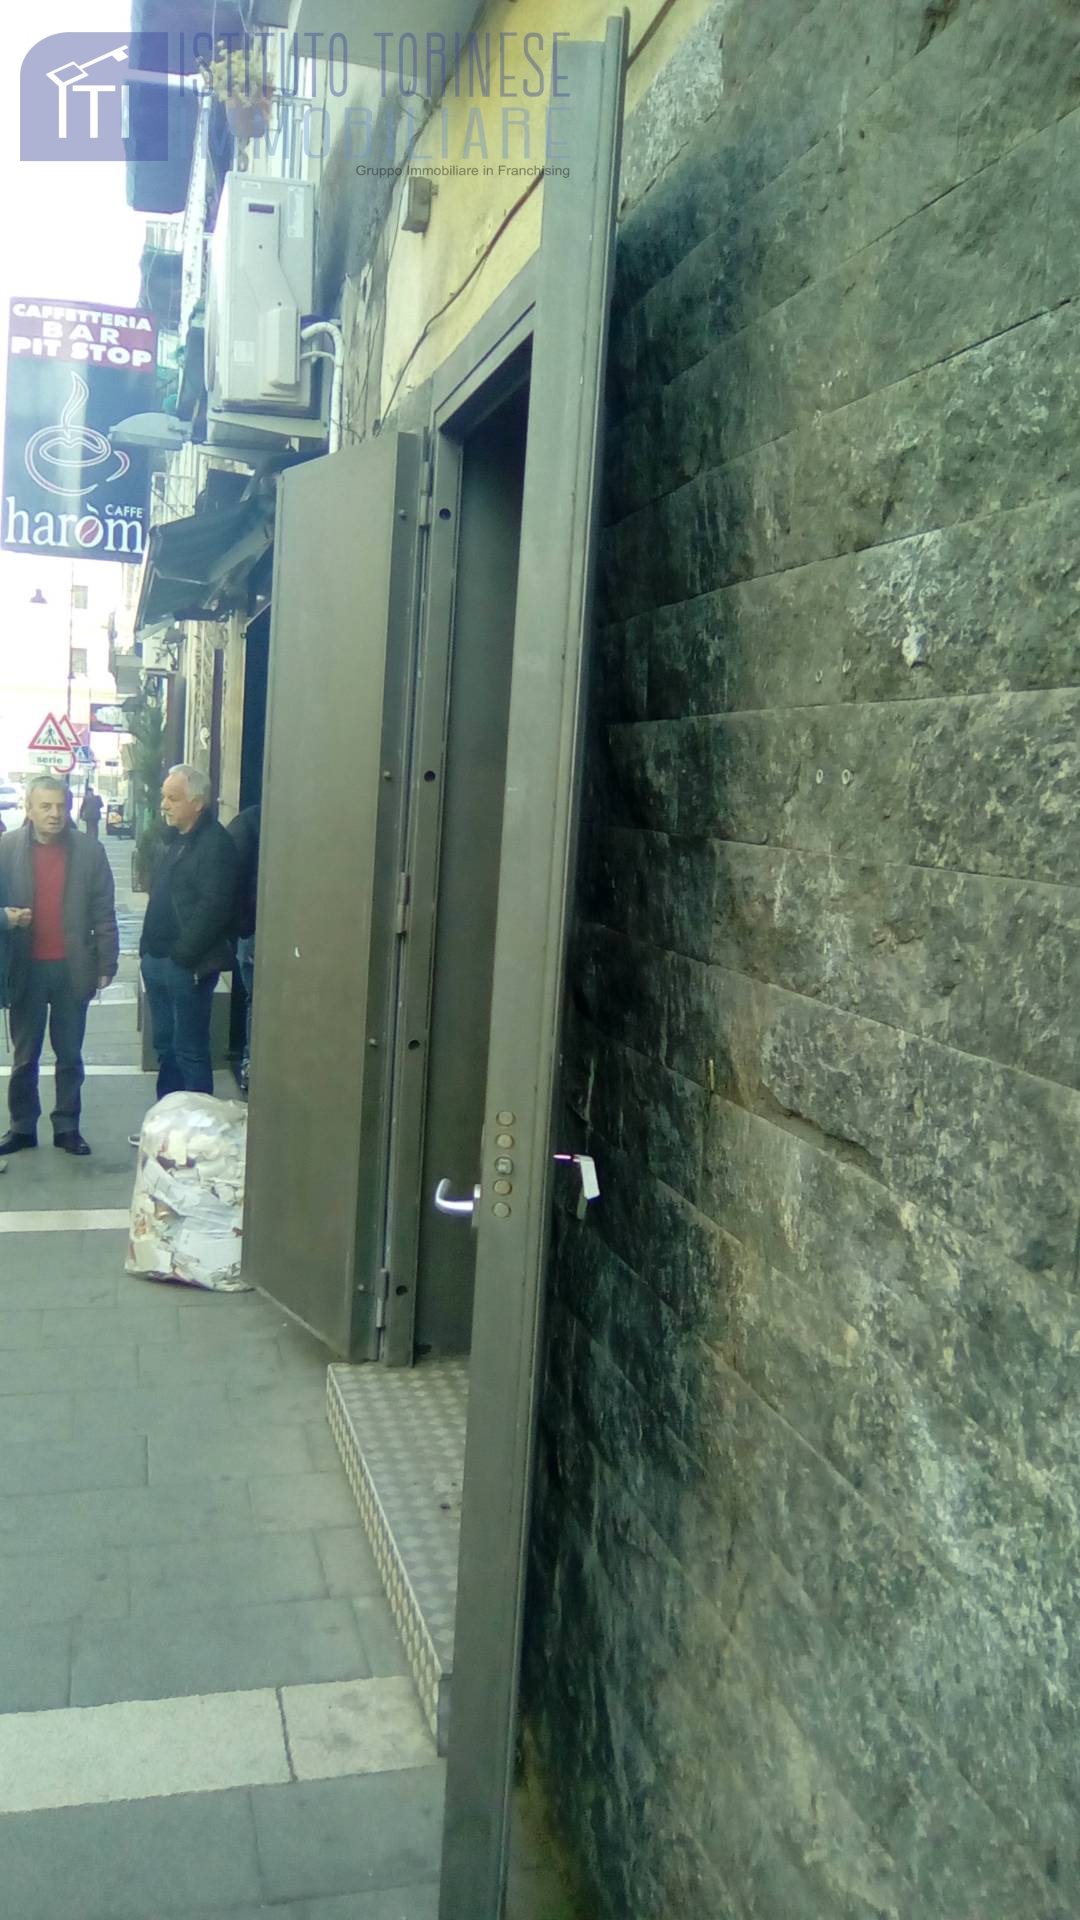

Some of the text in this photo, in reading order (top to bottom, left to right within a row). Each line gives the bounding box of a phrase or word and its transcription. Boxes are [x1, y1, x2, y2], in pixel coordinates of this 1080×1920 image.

[11, 303, 152, 332] CAFFETTERIA
[42, 320, 121, 345] BAR
[10, 336, 152, 368] PIT STOP
